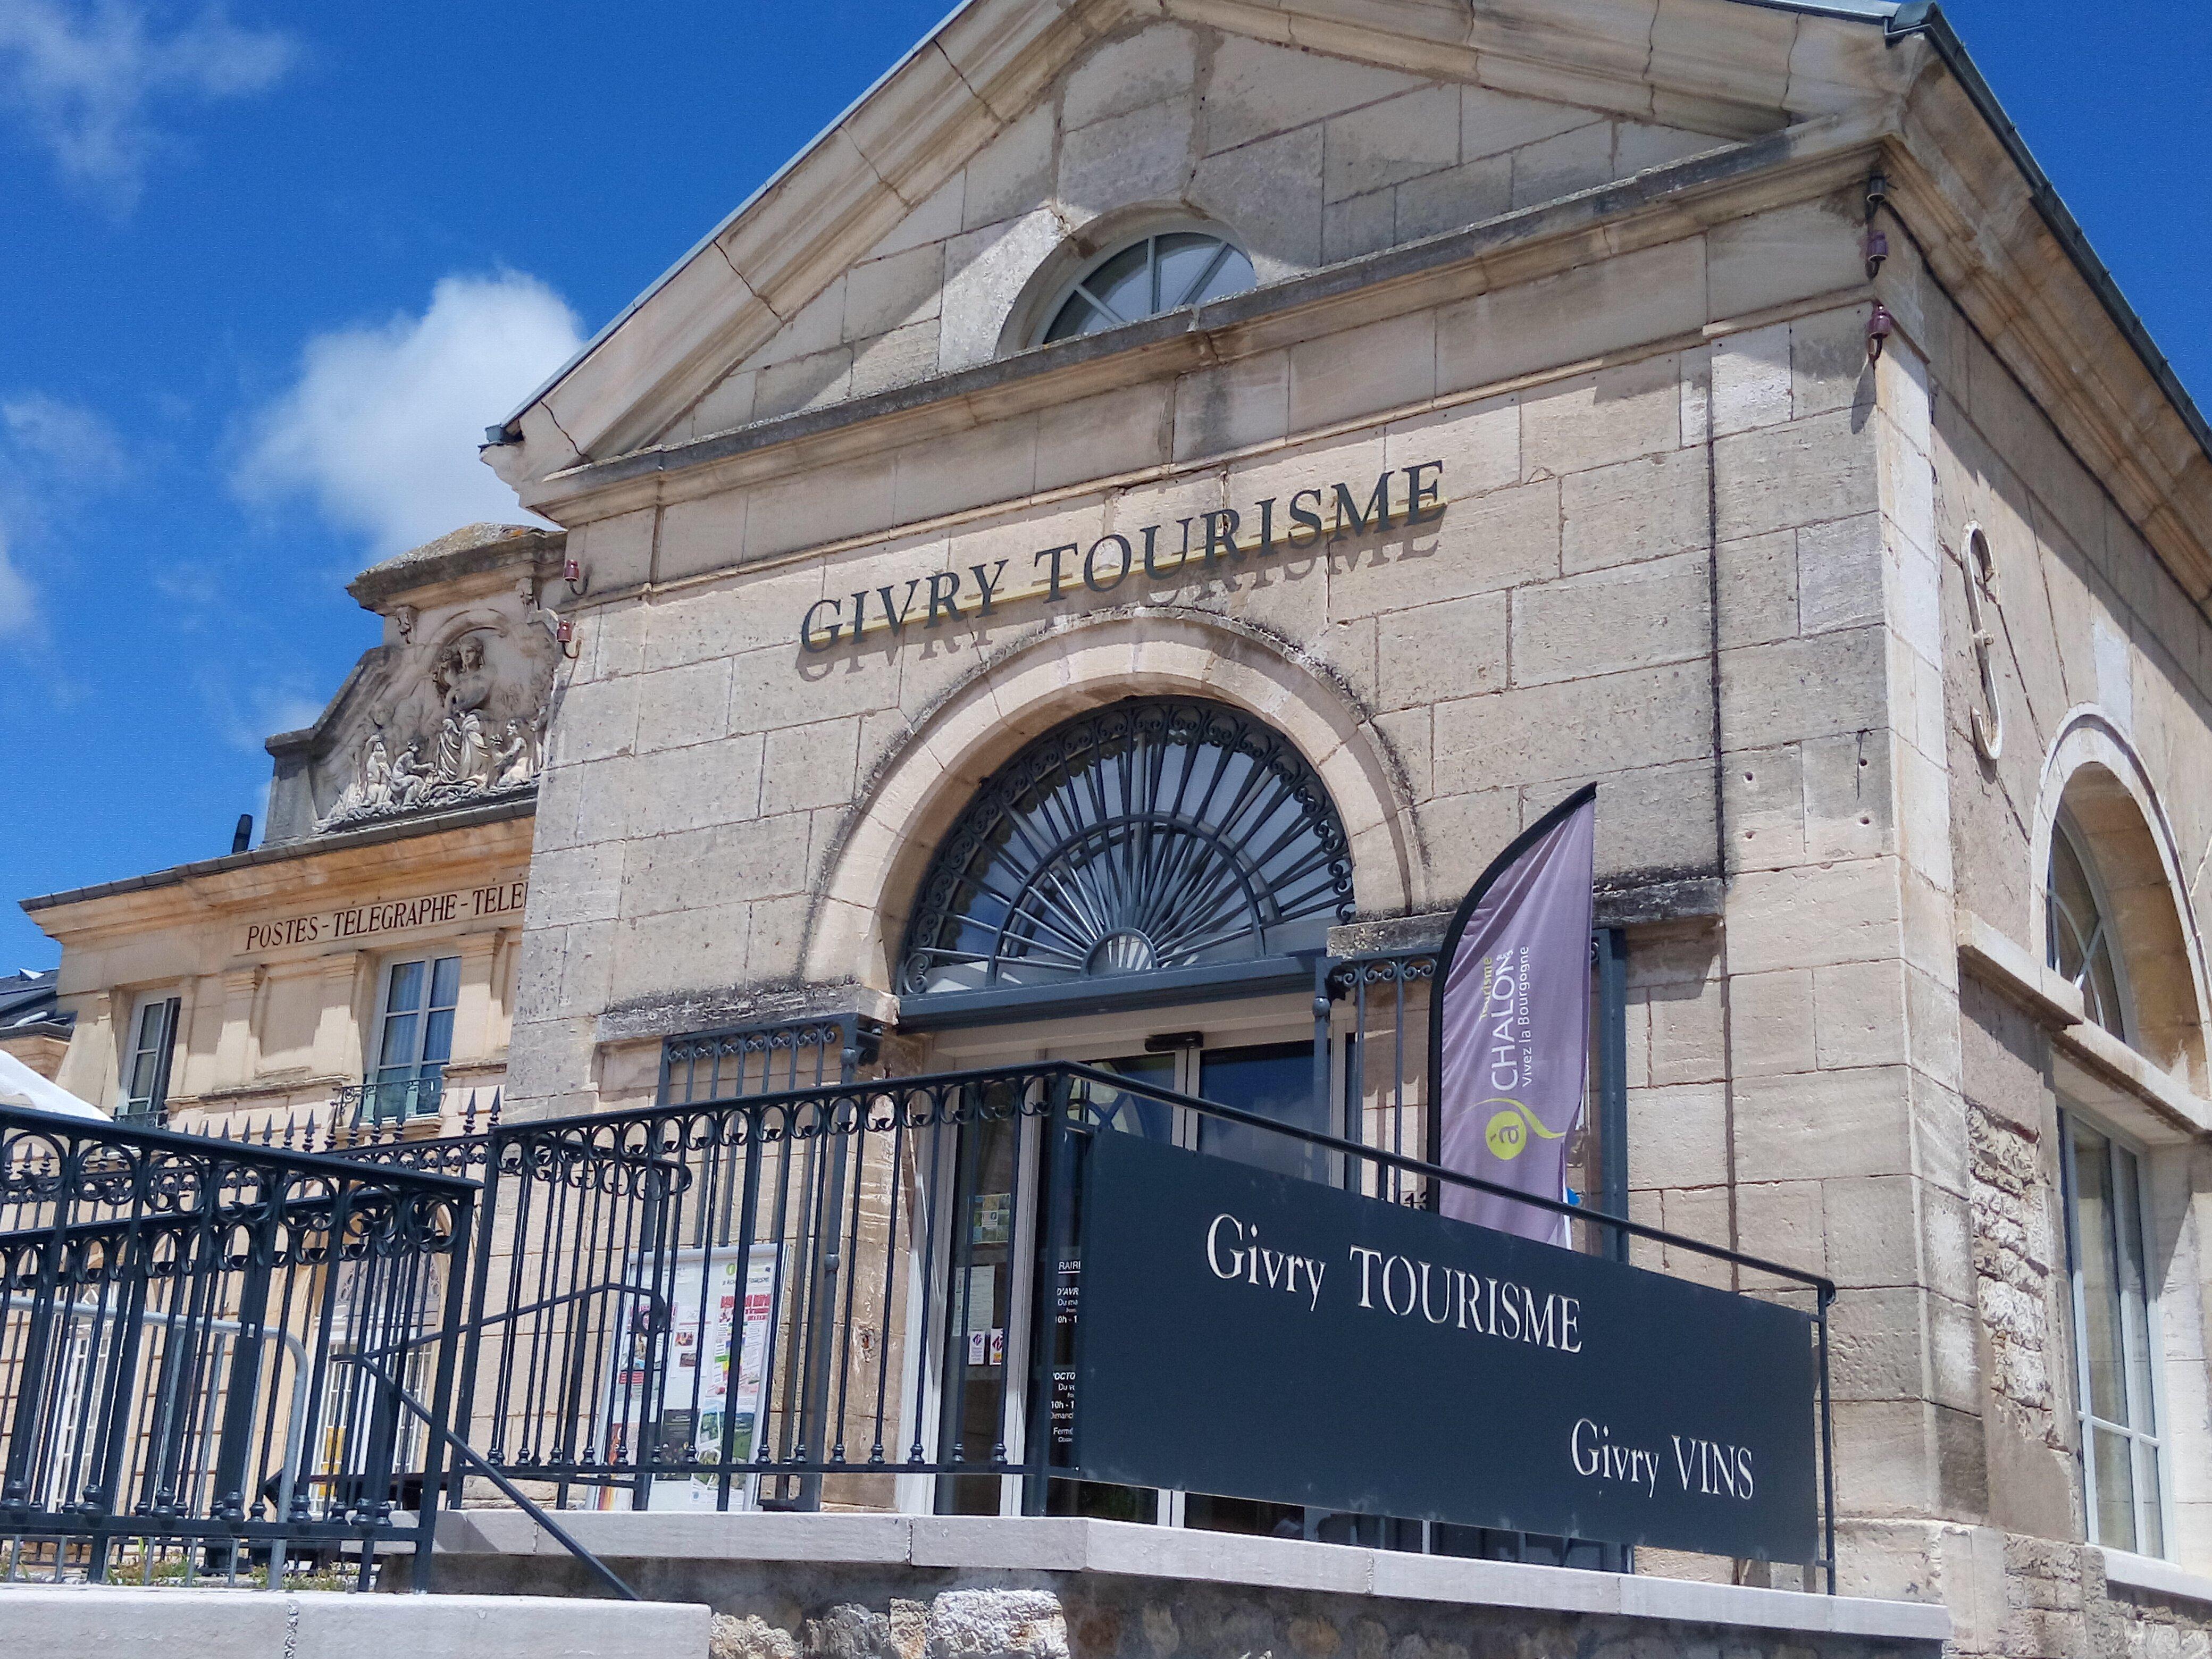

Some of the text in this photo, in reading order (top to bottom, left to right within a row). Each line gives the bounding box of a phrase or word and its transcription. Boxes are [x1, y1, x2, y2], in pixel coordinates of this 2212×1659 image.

[801, 460, 1447, 653] GIVRY TOURISME
[246, 917, 318, 951] POSTES
[1490, 949, 1519, 1091] CHALON
[1517, 946, 1532, 1088] Vivez la Bourgogne
[1205, 1213, 1583, 1354] Givry TOURISME
[1570, 1418, 1754, 1501] Givry VINS
